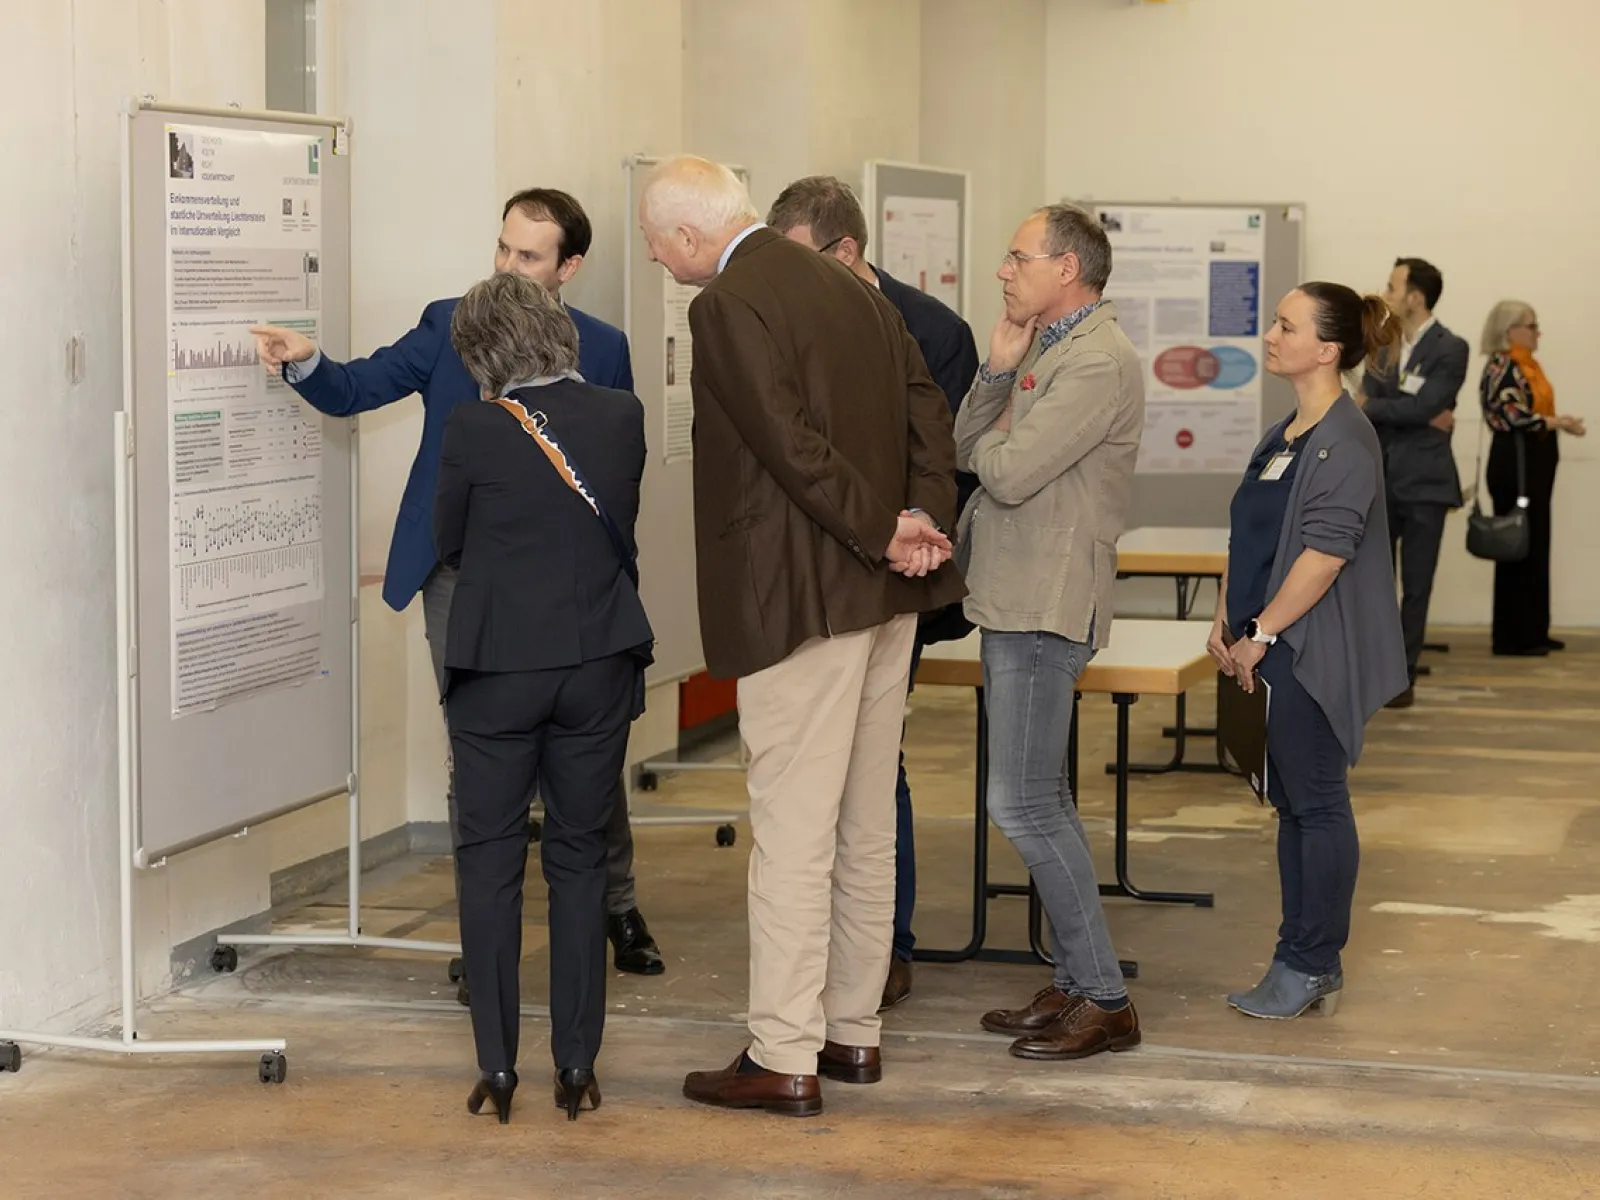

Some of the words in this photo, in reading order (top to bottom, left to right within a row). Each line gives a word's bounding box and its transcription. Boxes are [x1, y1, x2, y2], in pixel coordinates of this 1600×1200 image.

[170, 192, 228, 208] Einkommensverteilung
[229, 196, 241, 206] und
[170, 209, 195, 220] staatliche
[196, 209, 230, 224] Umverteilung
[231, 211, 266, 222] Liechtensteins
[178, 224, 217, 236] internationalen
[218, 225, 241, 239] Vergleich
